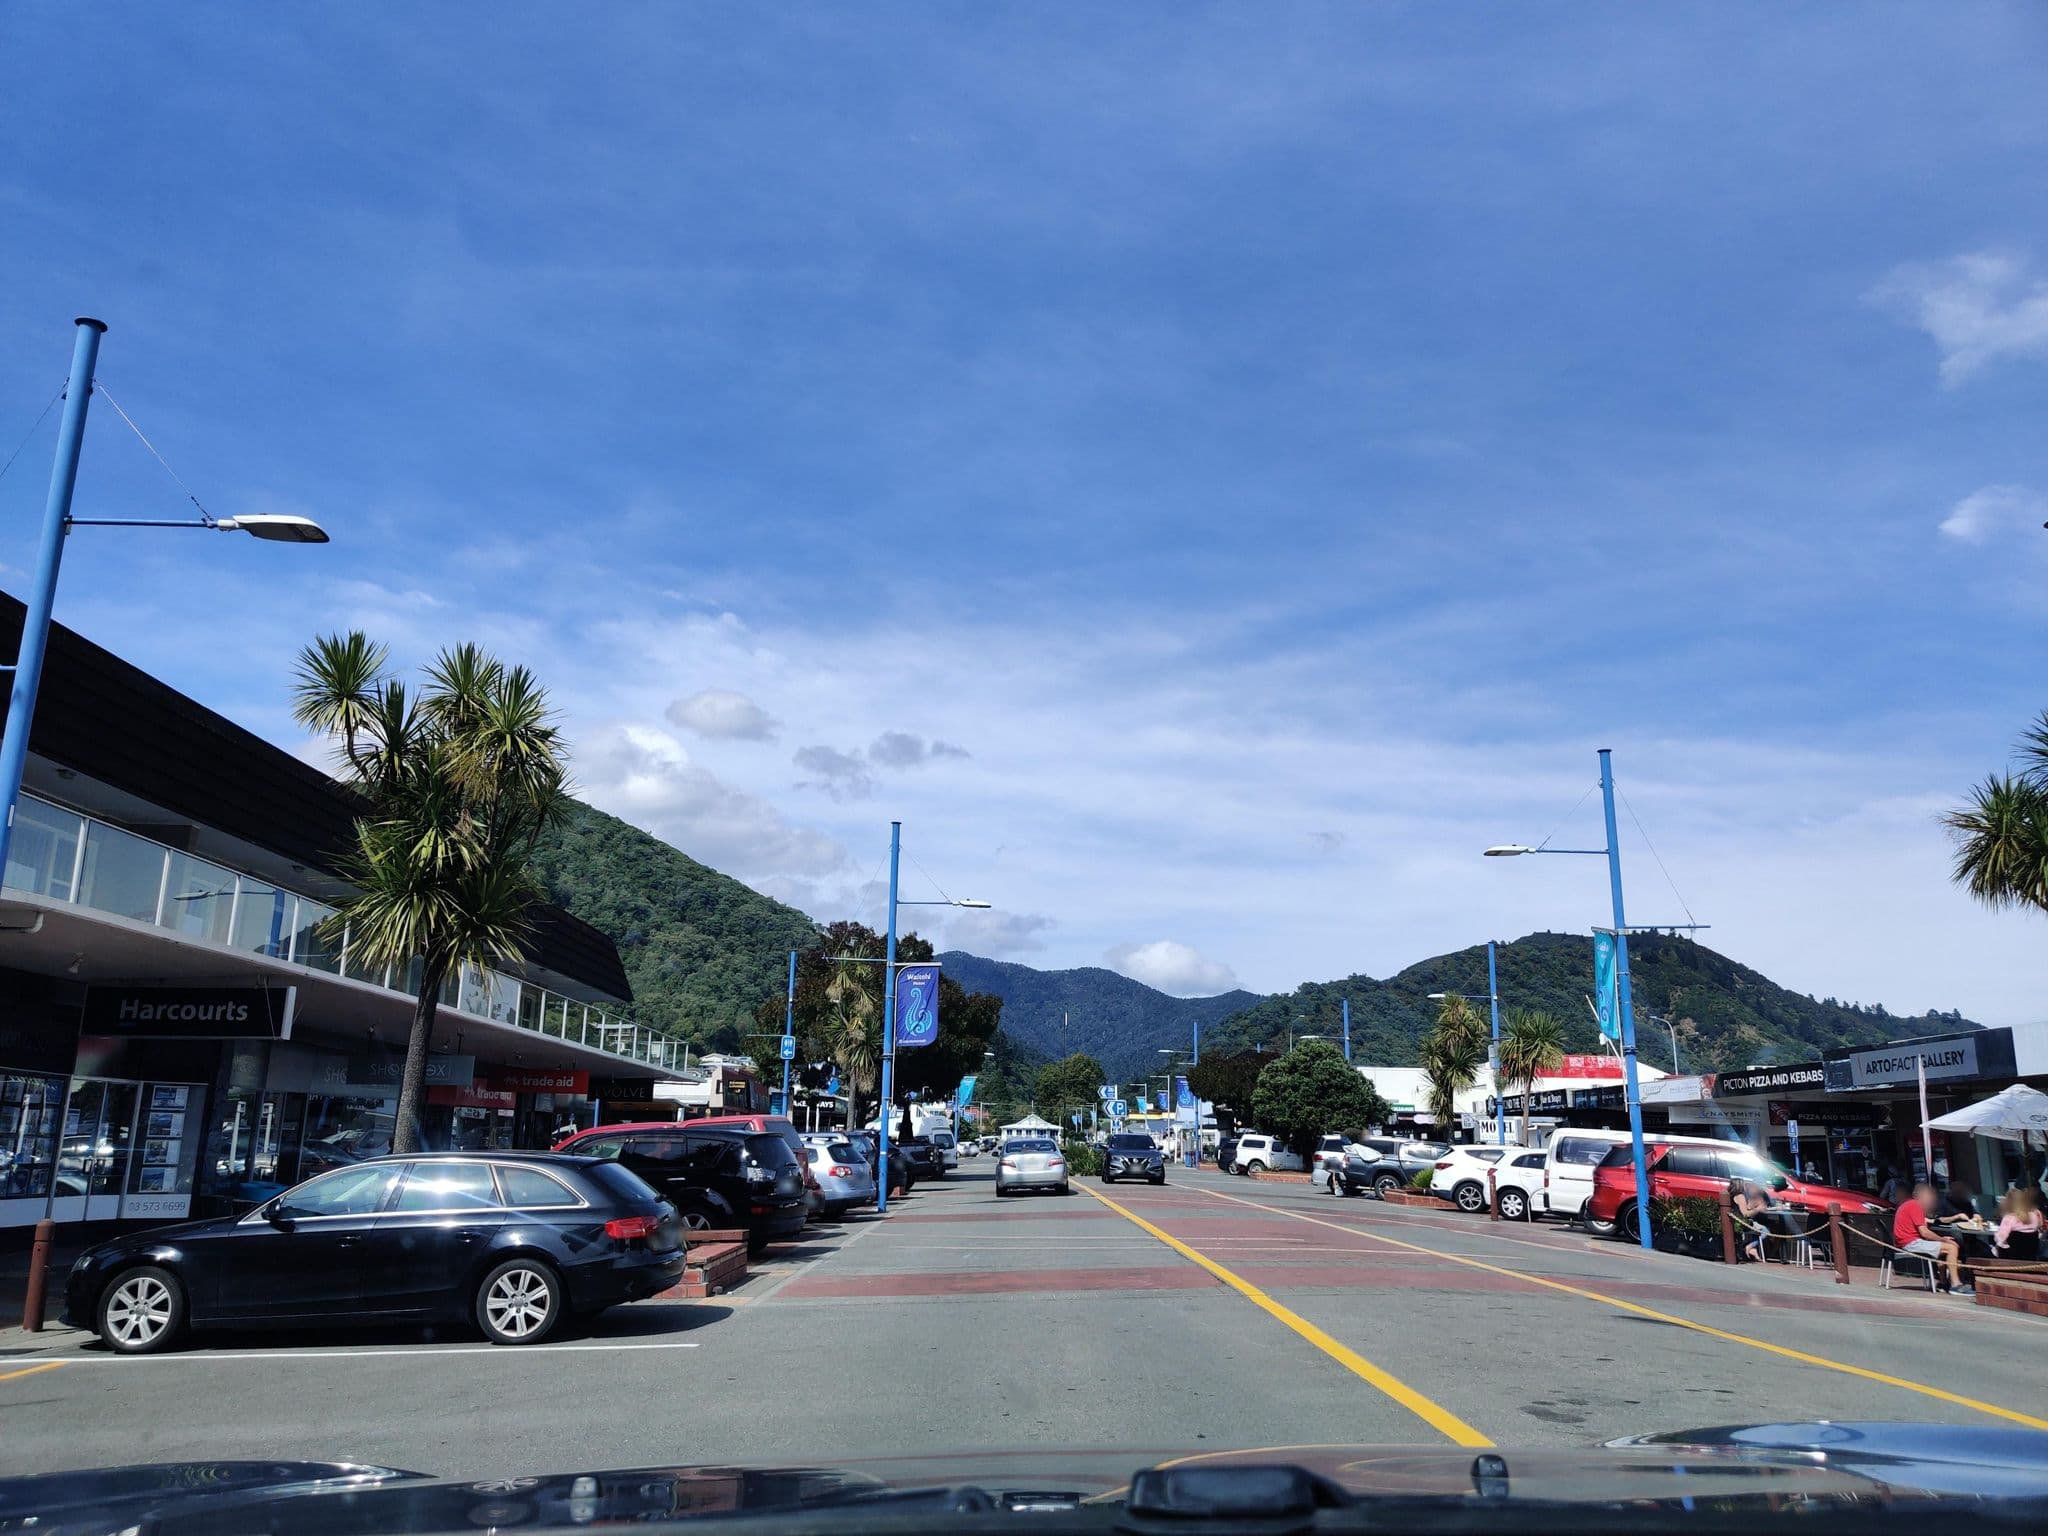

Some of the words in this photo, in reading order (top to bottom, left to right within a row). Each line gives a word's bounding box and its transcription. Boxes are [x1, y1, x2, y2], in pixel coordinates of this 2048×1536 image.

[119, 999, 248, 1021] Harcourts
[1865, 1056, 1916, 1075] ARTOFACT
[1920, 1049, 1965, 1069] GALLERY
[522, 1076, 554, 1087] trade
[556, 1076, 574, 1087] aid
[1723, 1077, 1748, 1090] PICTON
[1749, 1075, 1771, 1088] PIZZA
[1772, 1074, 1788, 1086] AND
[1790, 1069, 1824, 1083] KEBABS
[1117, 1102, 1124, 1114] P
[1798, 1113, 1820, 1121] PIZZA
[1481, 1121, 1513, 1133] MOEL
[143, 1201, 160, 1211] 573
